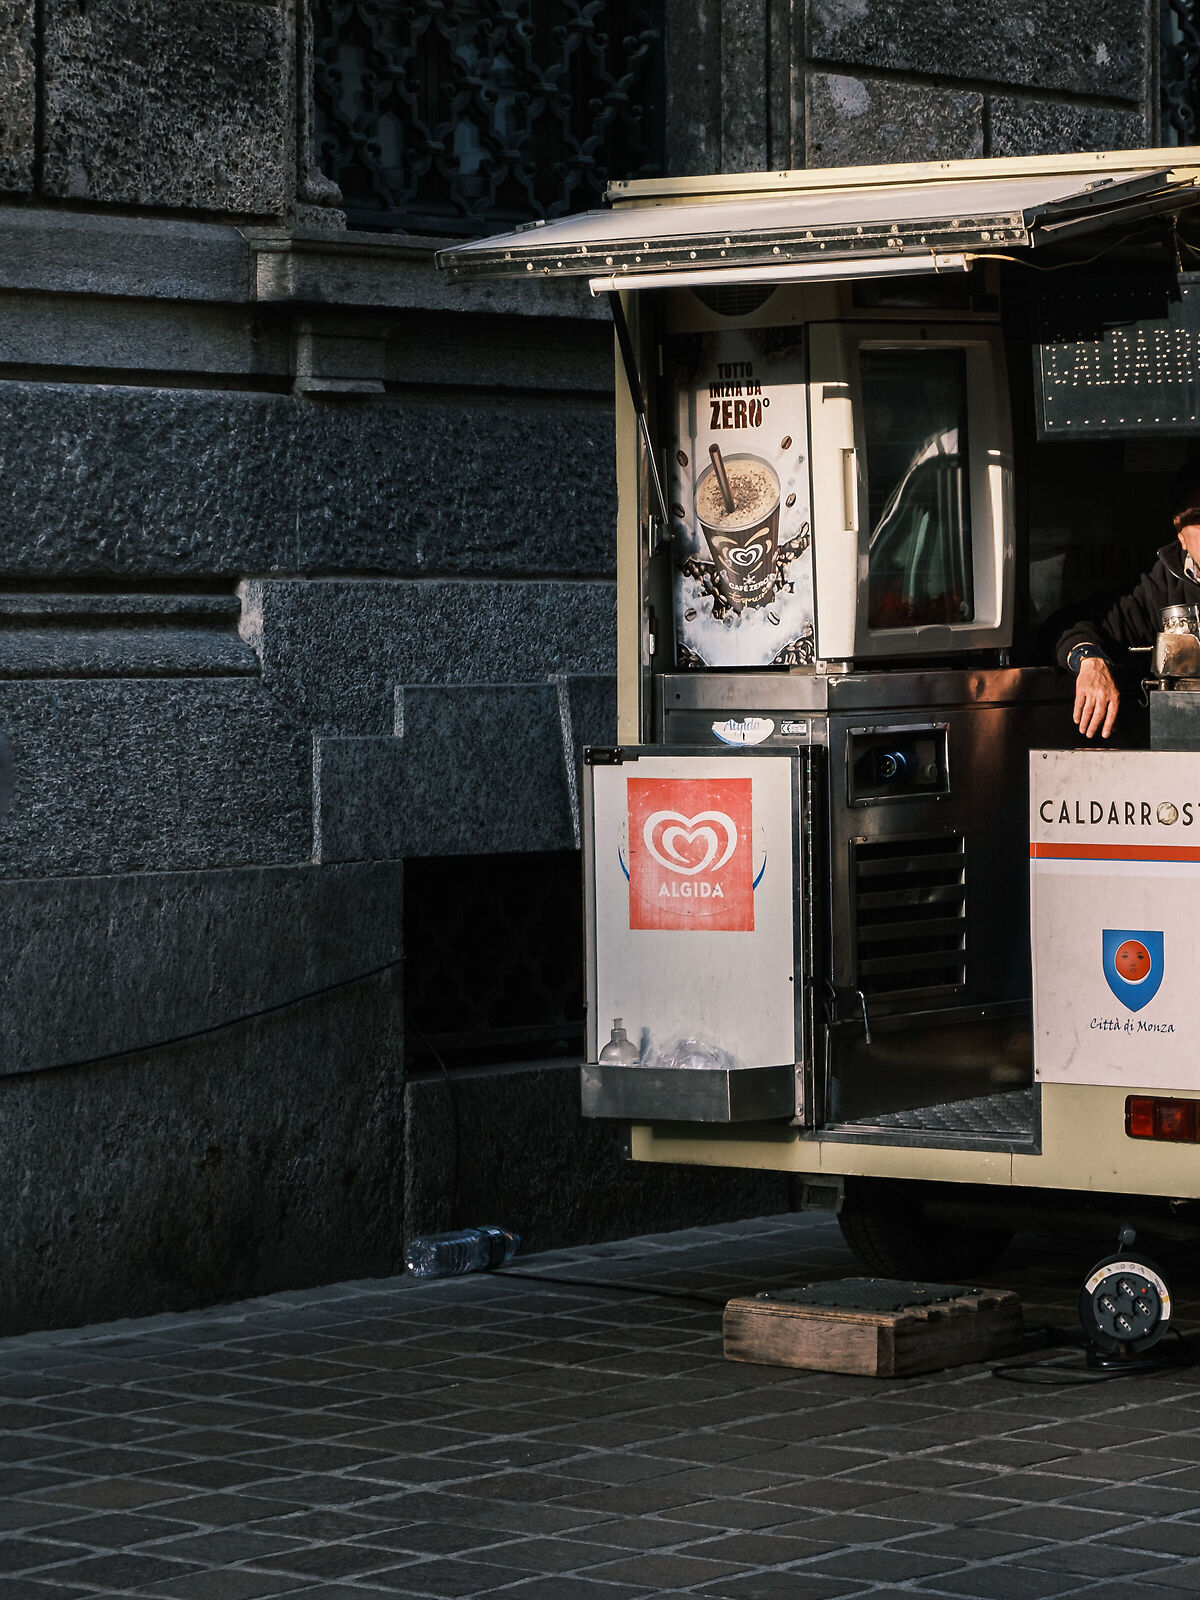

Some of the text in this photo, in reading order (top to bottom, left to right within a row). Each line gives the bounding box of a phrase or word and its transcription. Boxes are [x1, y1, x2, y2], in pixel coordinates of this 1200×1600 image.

[717, 362, 753, 379] TUTTO
[709, 379, 762, 398] INIZIA DA
[659, 881, 724, 898] ALGIDA
[1090, 1017, 1175, 1036] Città di Monza
